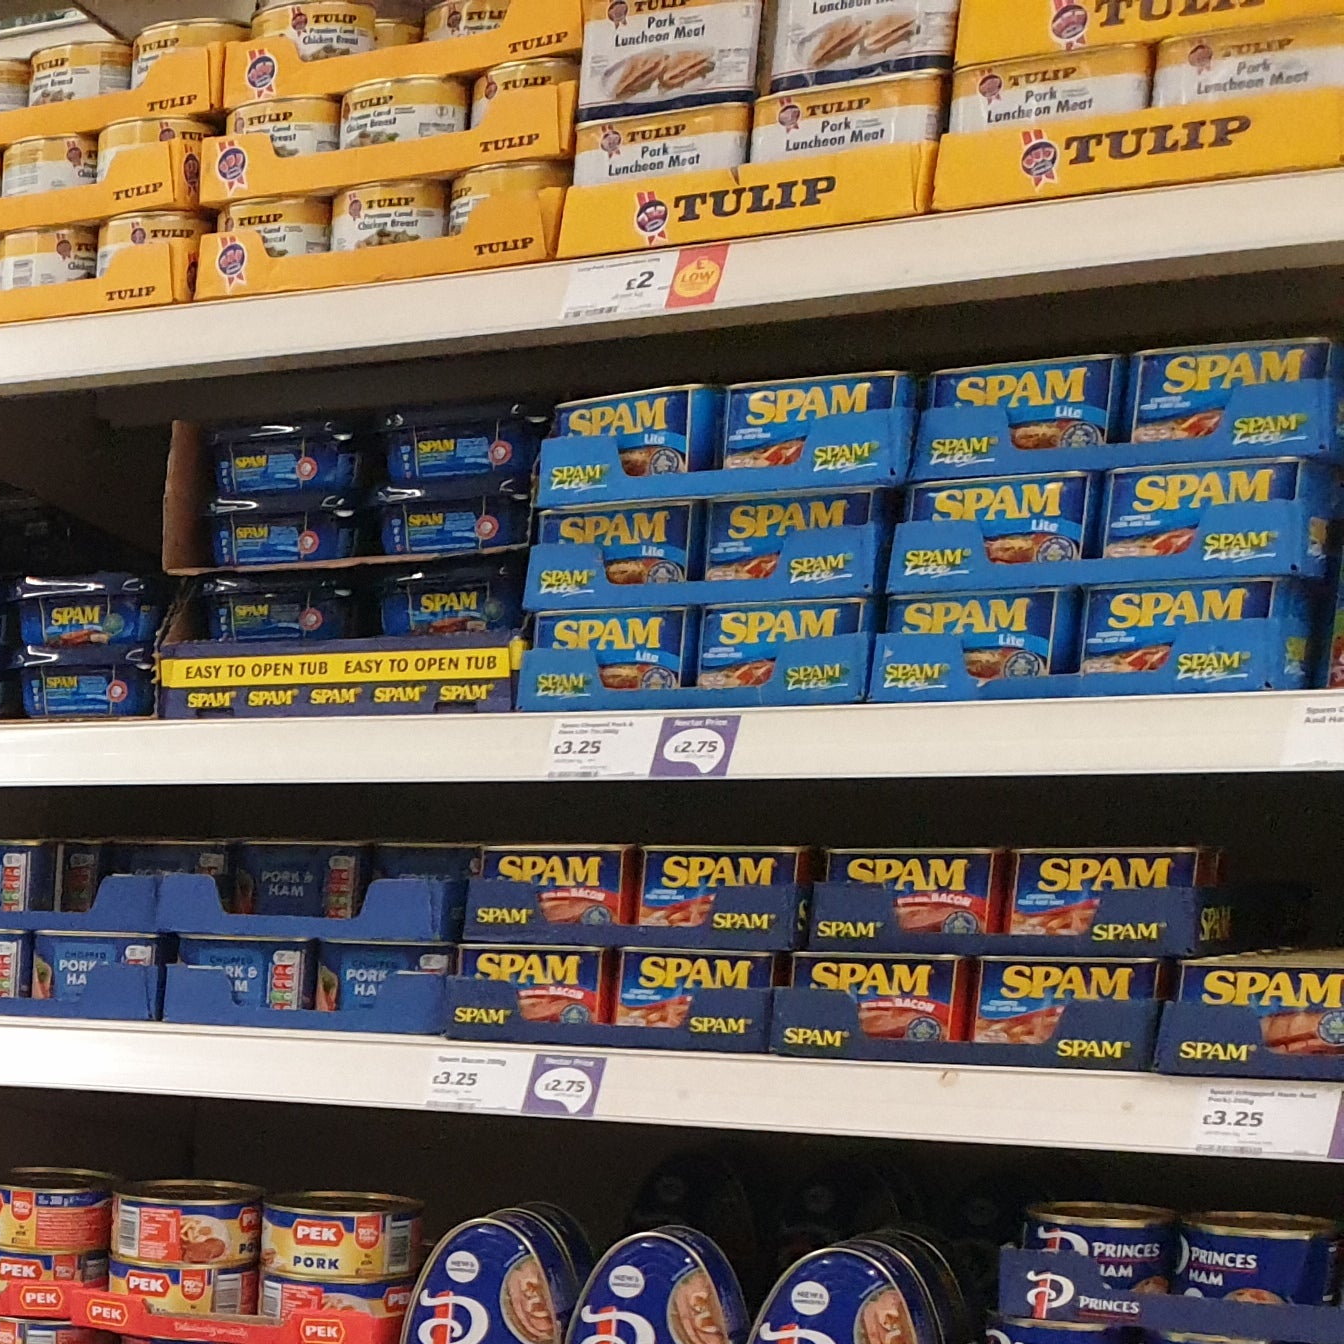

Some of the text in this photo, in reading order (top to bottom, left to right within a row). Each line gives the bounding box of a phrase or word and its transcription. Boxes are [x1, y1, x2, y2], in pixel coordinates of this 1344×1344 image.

[615, 24, 706, 49] Luncheon Meat
[147, 94, 197, 114] TULIP
[1025, 87, 1058, 103] Pork
[987, 97, 1094, 124] Luncheon Meat
[821, 118, 852, 133] Pork
[785, 127, 885, 152] Luncheon Meat
[1065, 115, 1252, 166] TULIP
[674, 174, 837, 222] TULIP
[625, 270, 655, 292] £2
[680, 269, 715, 285] LOW
[746, 382, 872, 427] SPAM
[1055, 405, 1082, 418] Lite
[1132, 469, 1274, 513] SPAM
[1031, 520, 1058, 532] Lite
[185, 654, 498, 680] EASY TO OPEN TUB EASY TO OPEN TUB
[187, 683, 488, 708] SPAM SPAM SPAM SPAM SPAM
[554, 740, 601, 754] £3.25
[674, 741, 718, 753] £2.75
[1038, 856, 1173, 892] SPAM
[570, 888, 606, 901] BACON
[931, 892, 973, 907] BACON
[1000, 965, 1134, 1000] SPAM
[432, 1072, 478, 1086] £3.25
[544, 1080, 585, 1093] £2.75
[1202, 1111, 1263, 1128] £3.25
[296, 1224, 337, 1242] PEK
[1092, 1241, 1161, 1258] PRINCES
[1190, 1247, 1257, 1269] PRINCES
[292, 1256, 340, 1270] PORK
